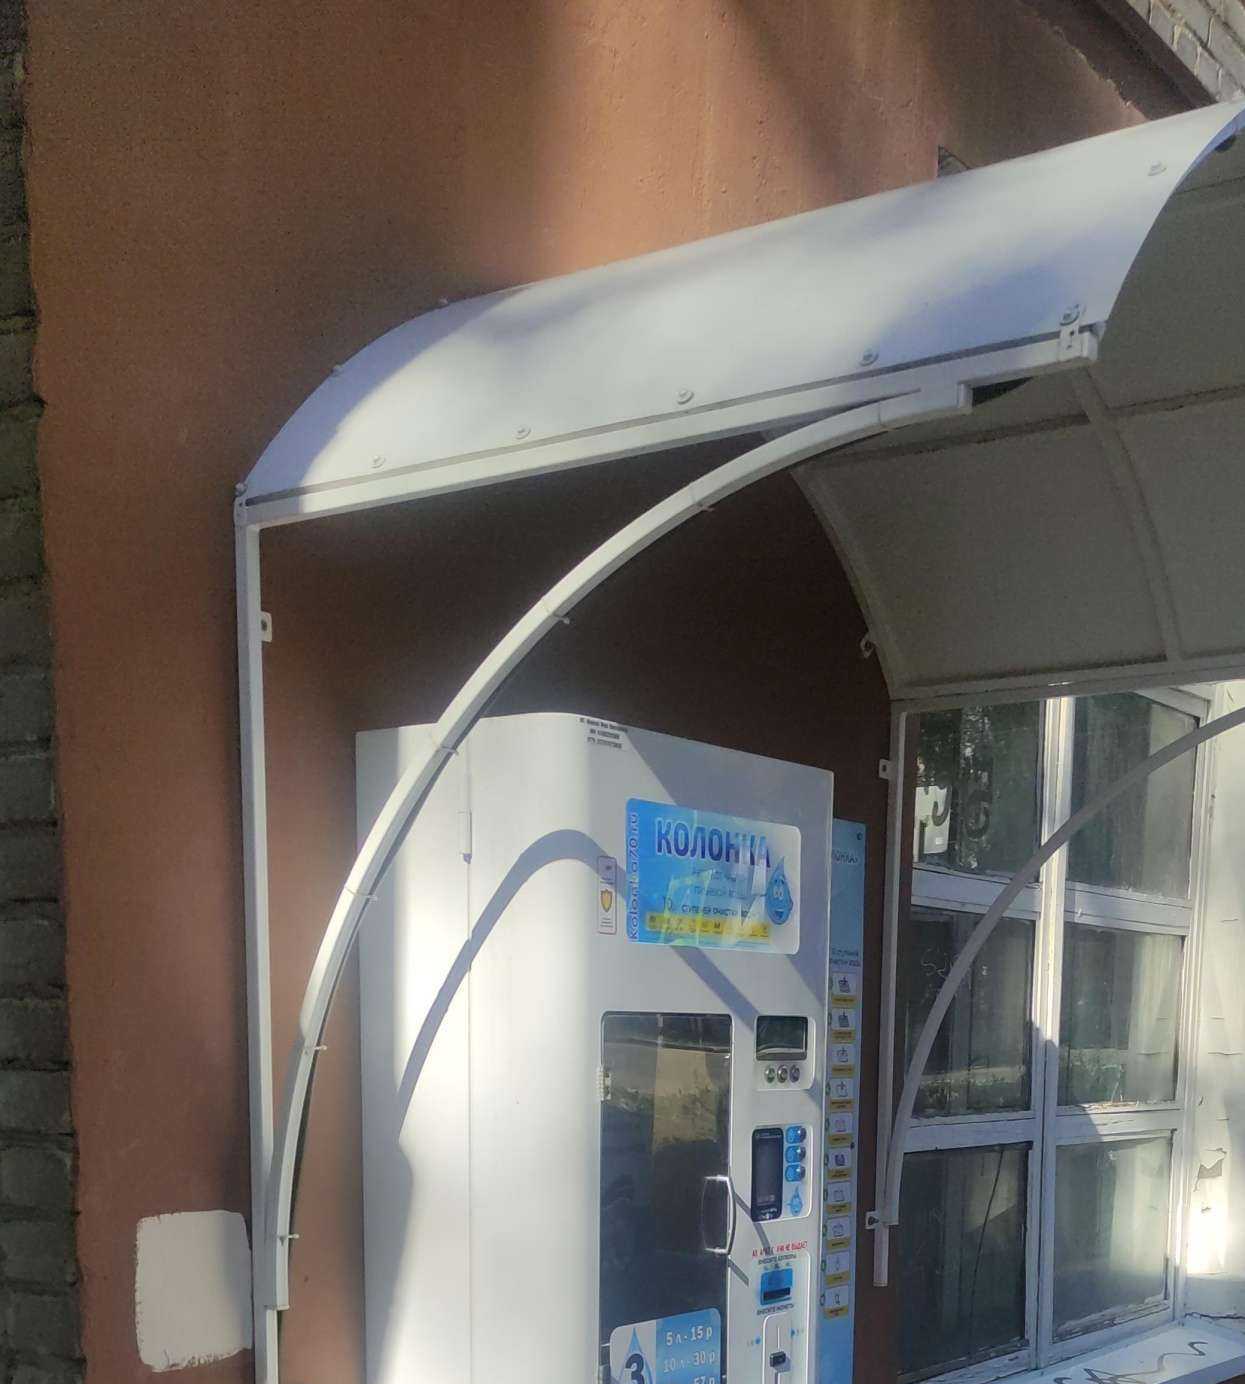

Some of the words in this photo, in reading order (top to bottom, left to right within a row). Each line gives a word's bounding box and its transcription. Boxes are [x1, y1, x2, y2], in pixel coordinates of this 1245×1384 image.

[666, 1331, 674, 1346] 5
[675, 1333, 682, 1344] л
[690, 1325, 705, 1341] 15
[706, 1327, 713, 1340] р
[663, 1359, 677, 1373] 10
[693, 1350, 707, 1366] 30
